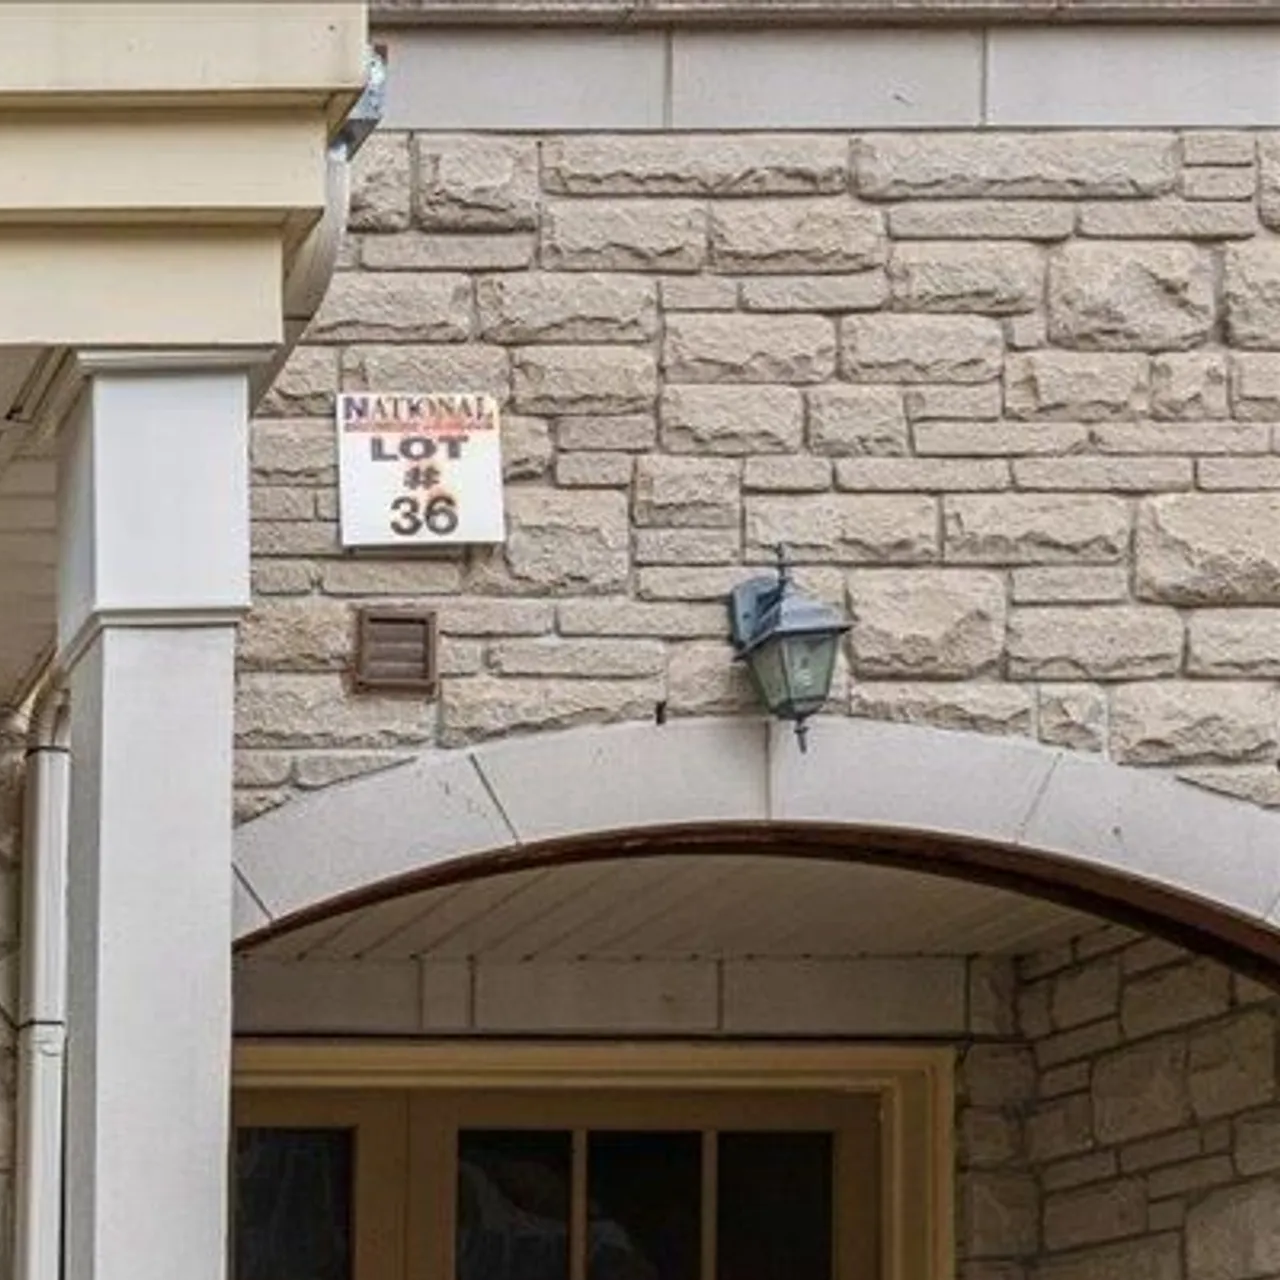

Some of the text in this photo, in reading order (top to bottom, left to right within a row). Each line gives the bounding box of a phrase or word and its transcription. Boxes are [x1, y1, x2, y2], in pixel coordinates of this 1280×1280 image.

[343, 396, 493, 420] NATIONAL
[370, 435, 469, 461] LOT
[390, 496, 459, 536] 36
